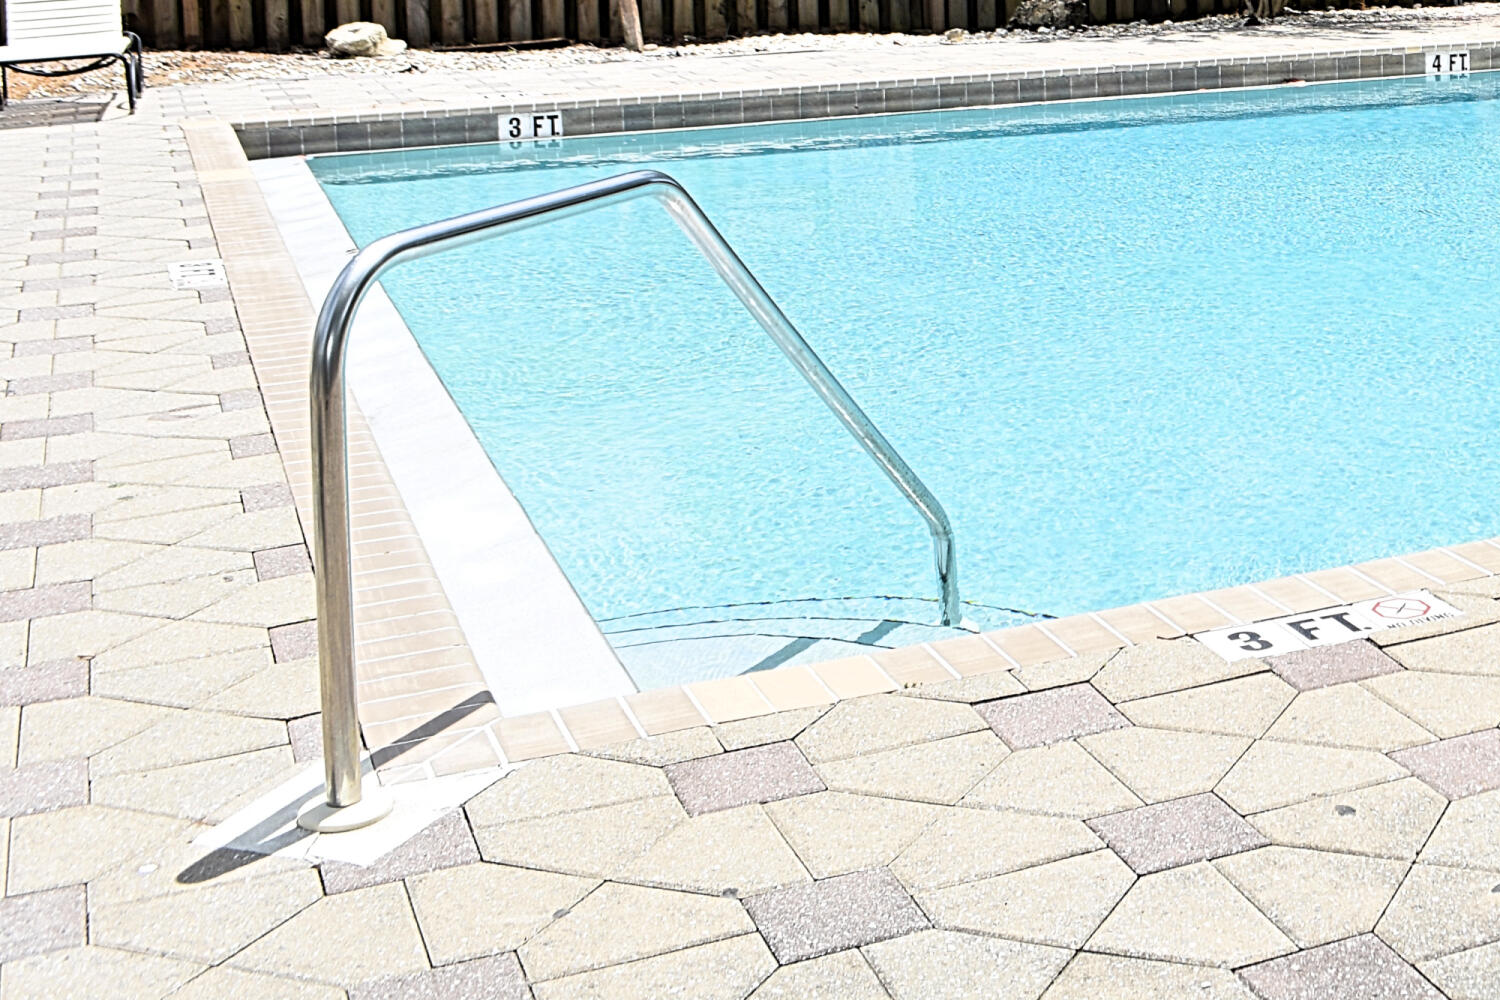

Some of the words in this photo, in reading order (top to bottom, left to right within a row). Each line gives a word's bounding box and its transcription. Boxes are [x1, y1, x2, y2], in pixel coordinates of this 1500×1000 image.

[1432, 54, 1442, 72] 4
[1449, 53, 1468, 72] FT.
[508, 117, 522, 138] 3
[533, 115, 560, 137] FT.
[1227, 631, 1274, 651] 3
[1286, 612, 1373, 641] FT.
